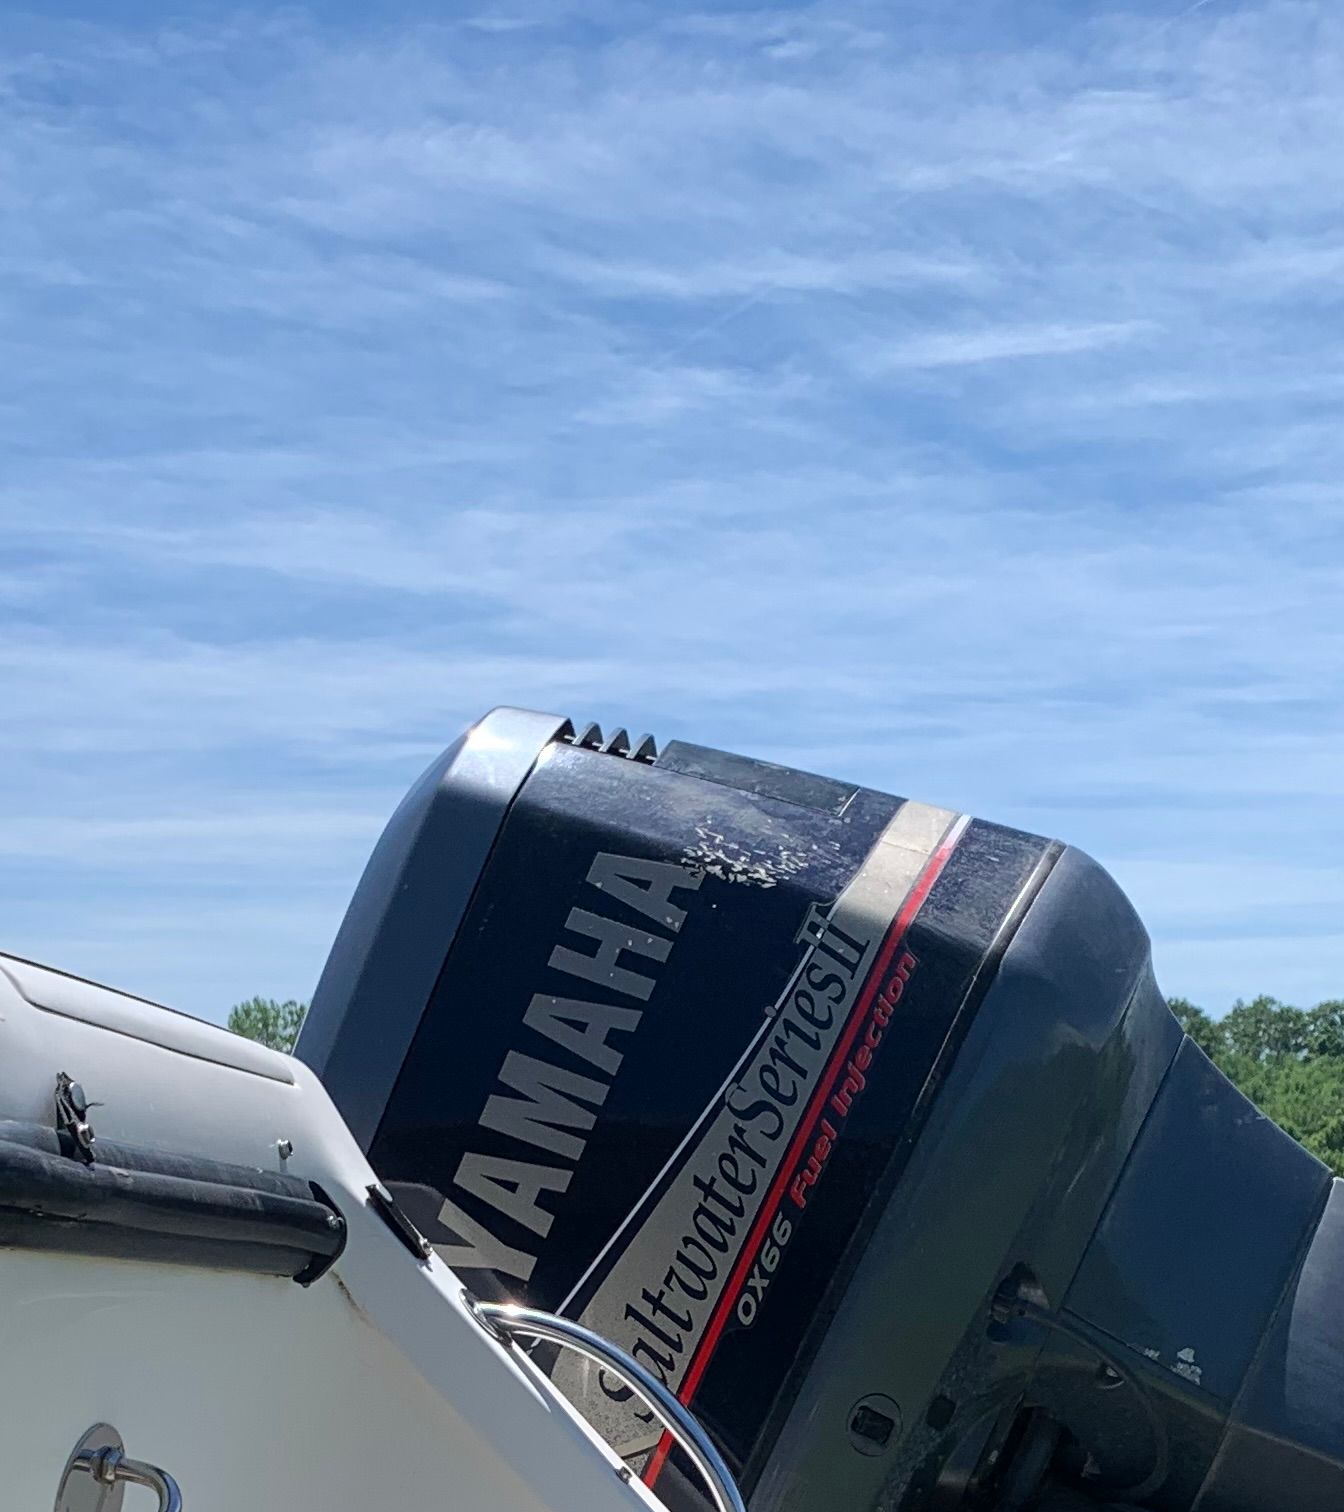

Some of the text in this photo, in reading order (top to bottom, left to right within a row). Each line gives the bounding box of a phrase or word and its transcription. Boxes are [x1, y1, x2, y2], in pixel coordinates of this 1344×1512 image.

[431, 851, 705, 1282] YAMAHA
[737, 952, 917, 1326] OX66 Fuel Injection
